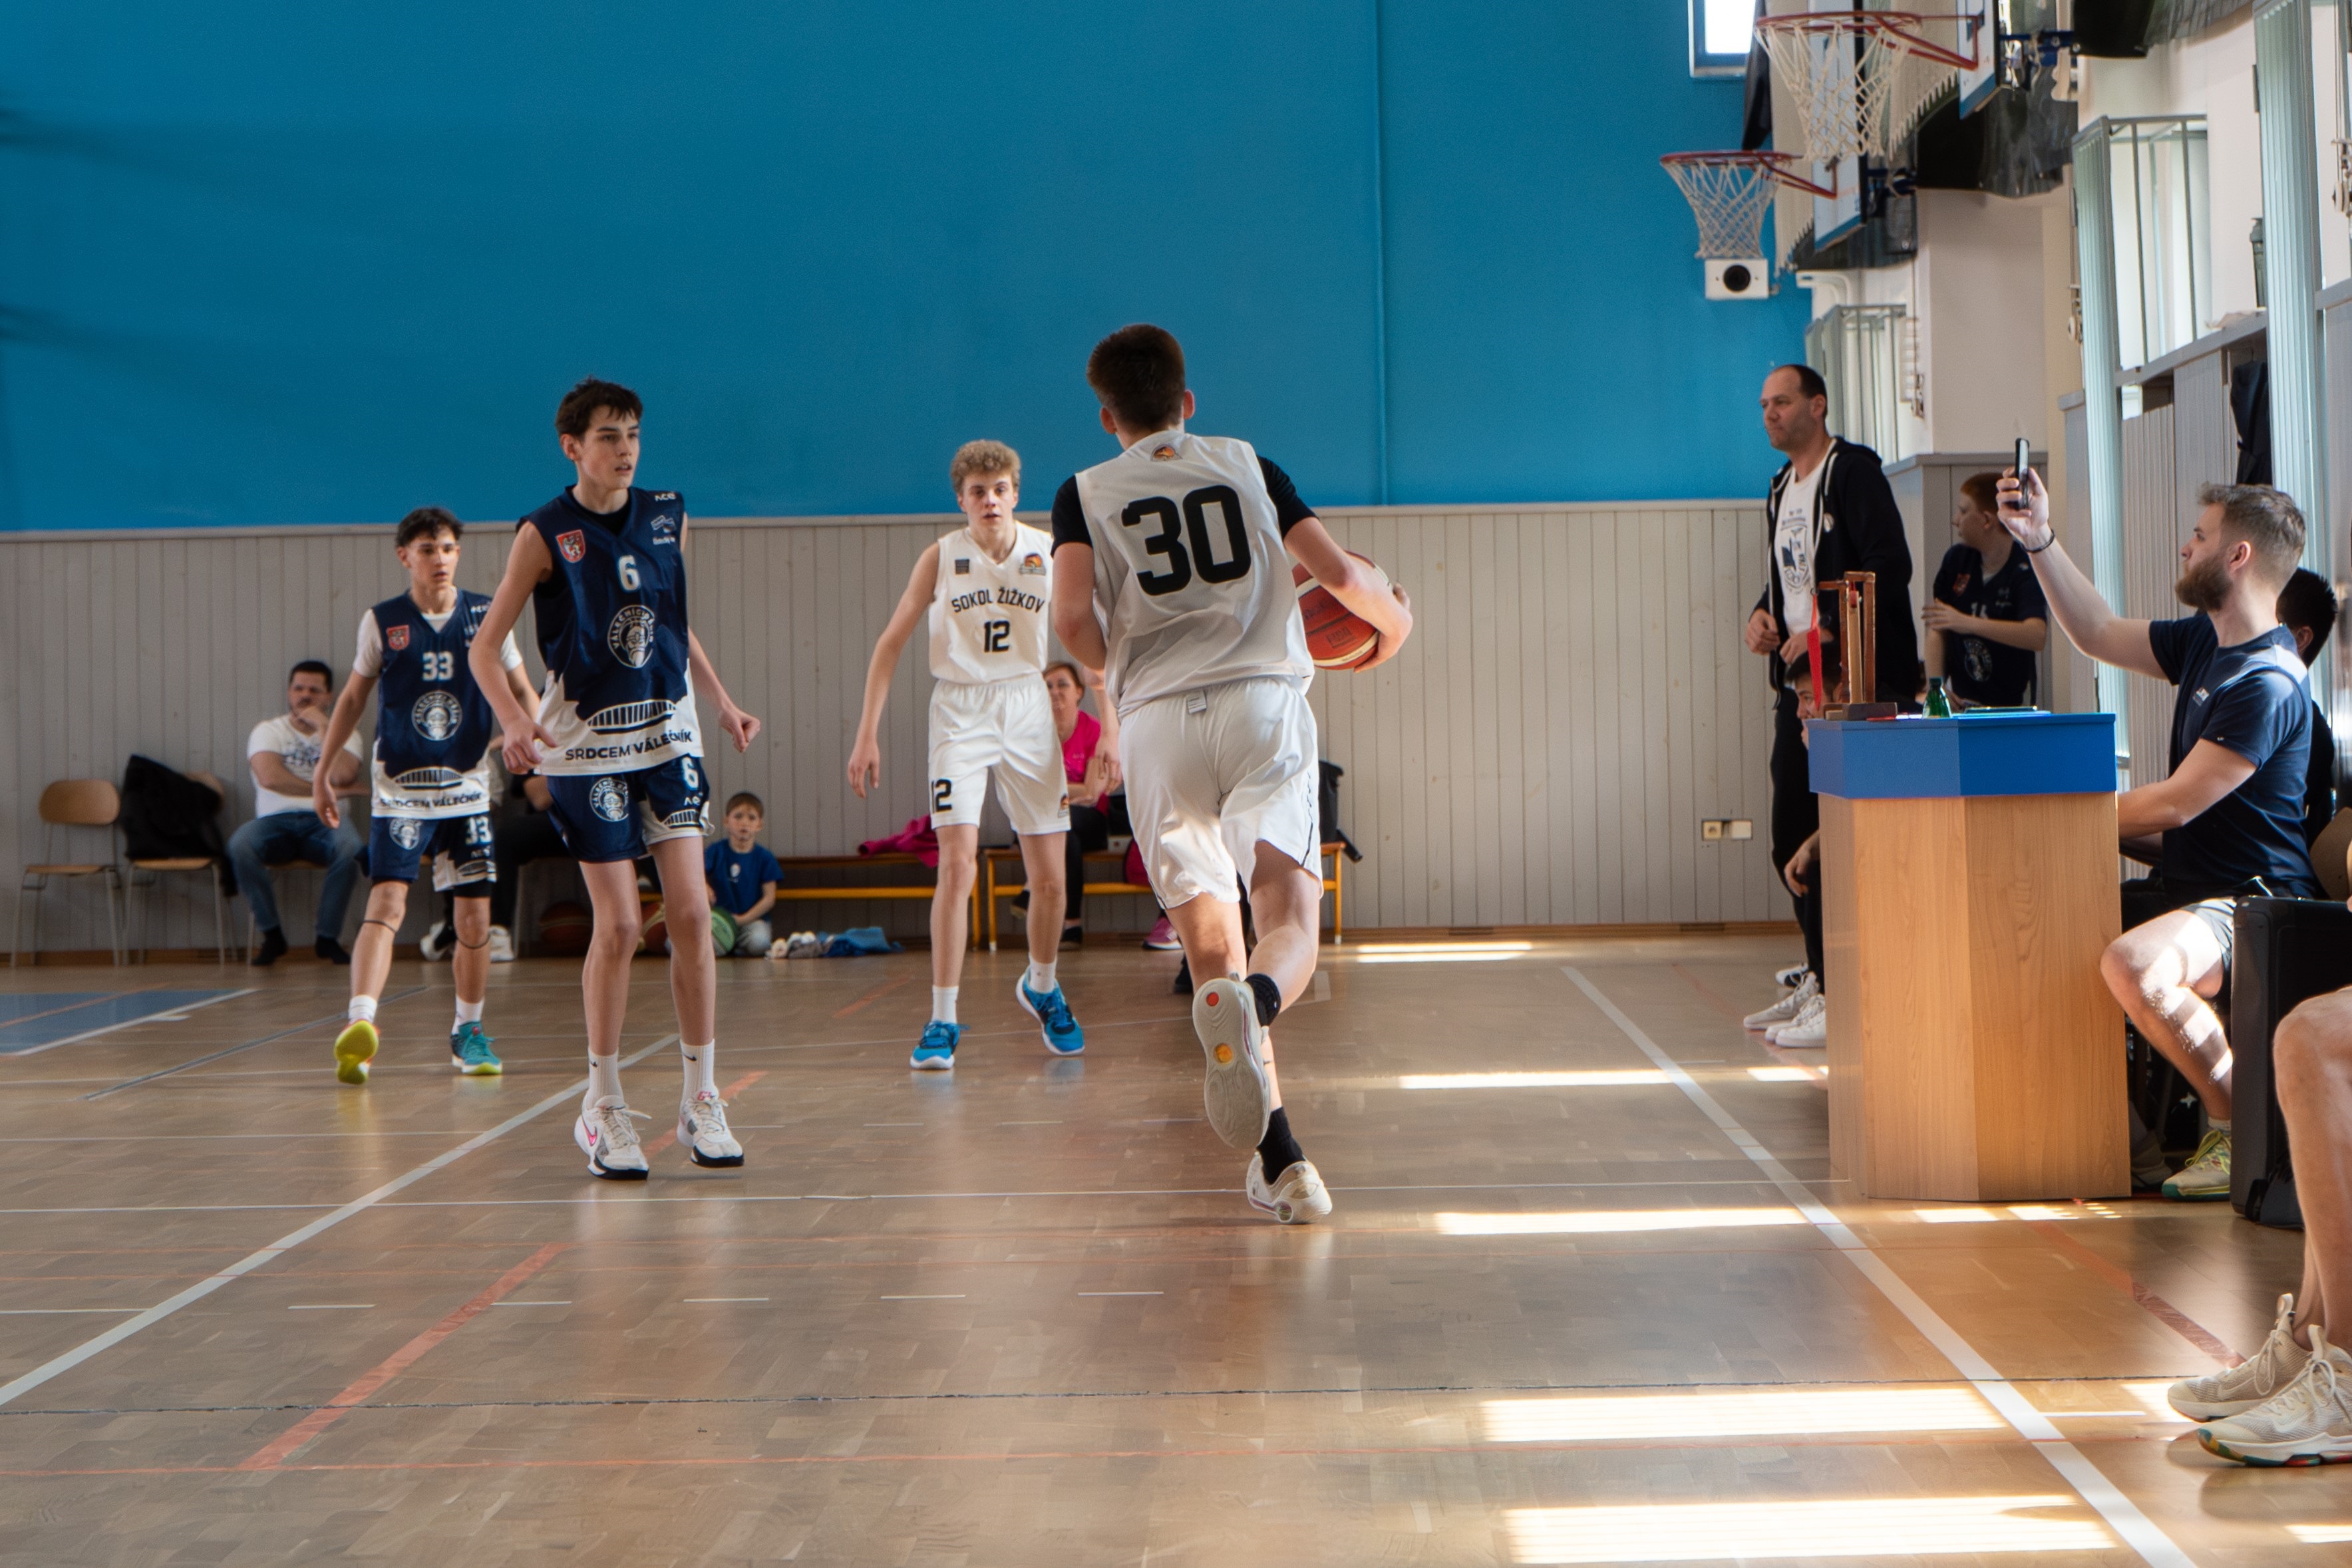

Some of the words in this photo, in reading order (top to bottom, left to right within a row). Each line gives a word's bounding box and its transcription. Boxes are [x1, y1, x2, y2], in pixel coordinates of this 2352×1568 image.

[1121, 485, 1252, 596] 30
[618, 554, 641, 591] 6
[951, 589, 993, 613] SOKOL
[997, 586, 1046, 613] ŽIŽKOV
[983, 620, 1011, 653] 12
[422, 651, 454, 682] 33
[565, 744, 631, 761] SRDCEM
[633, 729, 693, 754] VÁLEČNÍK
[681, 756, 699, 791] 6
